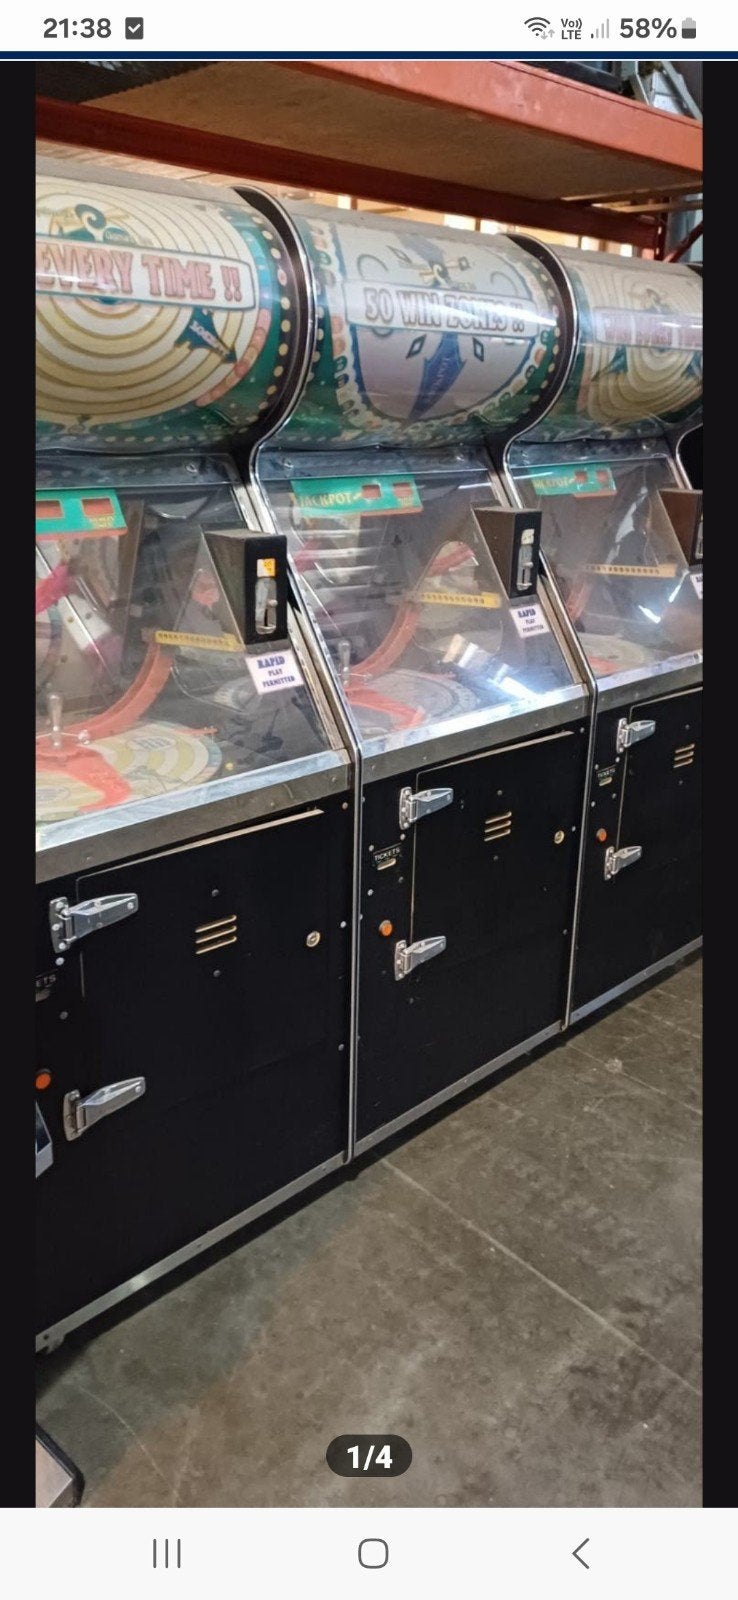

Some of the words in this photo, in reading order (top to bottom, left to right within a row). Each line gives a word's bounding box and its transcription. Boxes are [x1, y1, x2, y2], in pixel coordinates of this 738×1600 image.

[36, 241, 134, 295] EVERY
[141, 255, 216, 301] TIME
[363, 287, 395, 324] 50
[396, 290, 441, 328] WIN
[256, 655, 286, 670] RAPID
[267, 668, 283, 677] PLAY
[262, 675, 296, 688] PERMITTED
